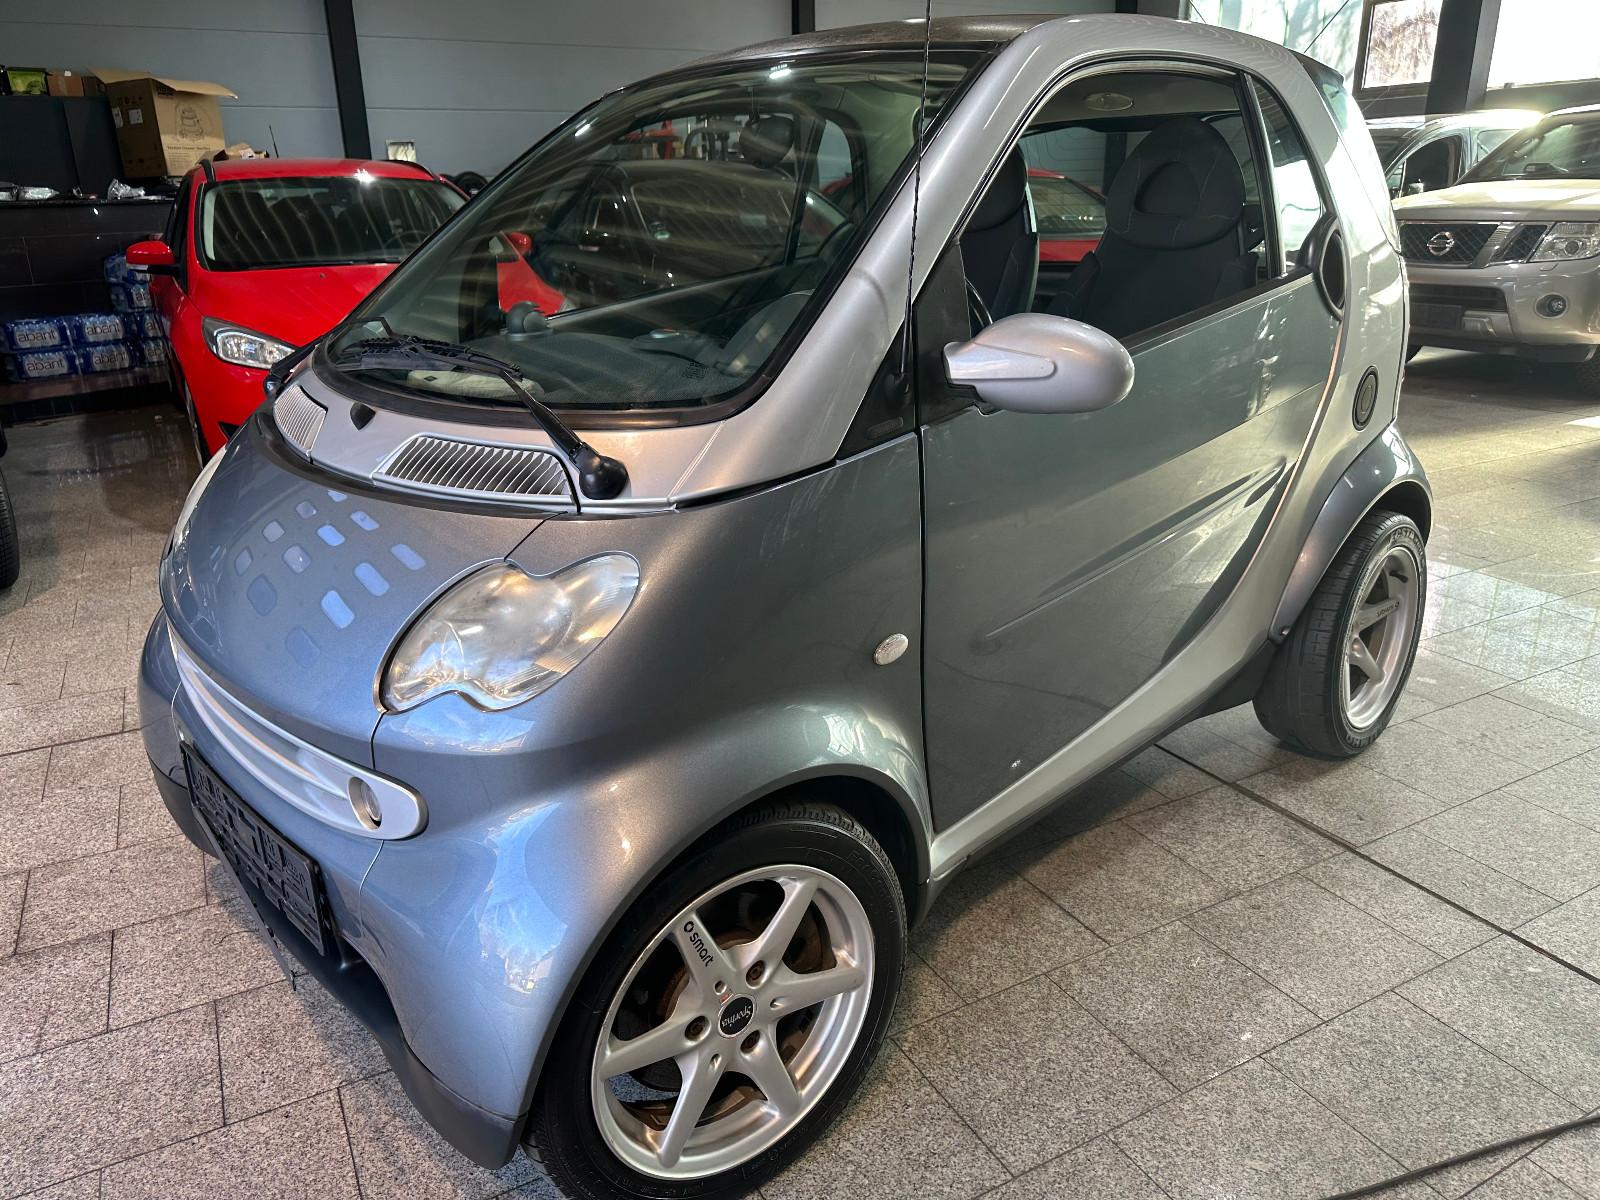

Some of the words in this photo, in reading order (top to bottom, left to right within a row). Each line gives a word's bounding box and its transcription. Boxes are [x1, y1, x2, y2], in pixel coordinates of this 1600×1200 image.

[86, 321, 121, 336] abant
[17, 329, 57, 343] abant
[26, 358, 65, 372] abant
[94, 351, 128, 365] abant
[689, 932, 714, 967] smart
